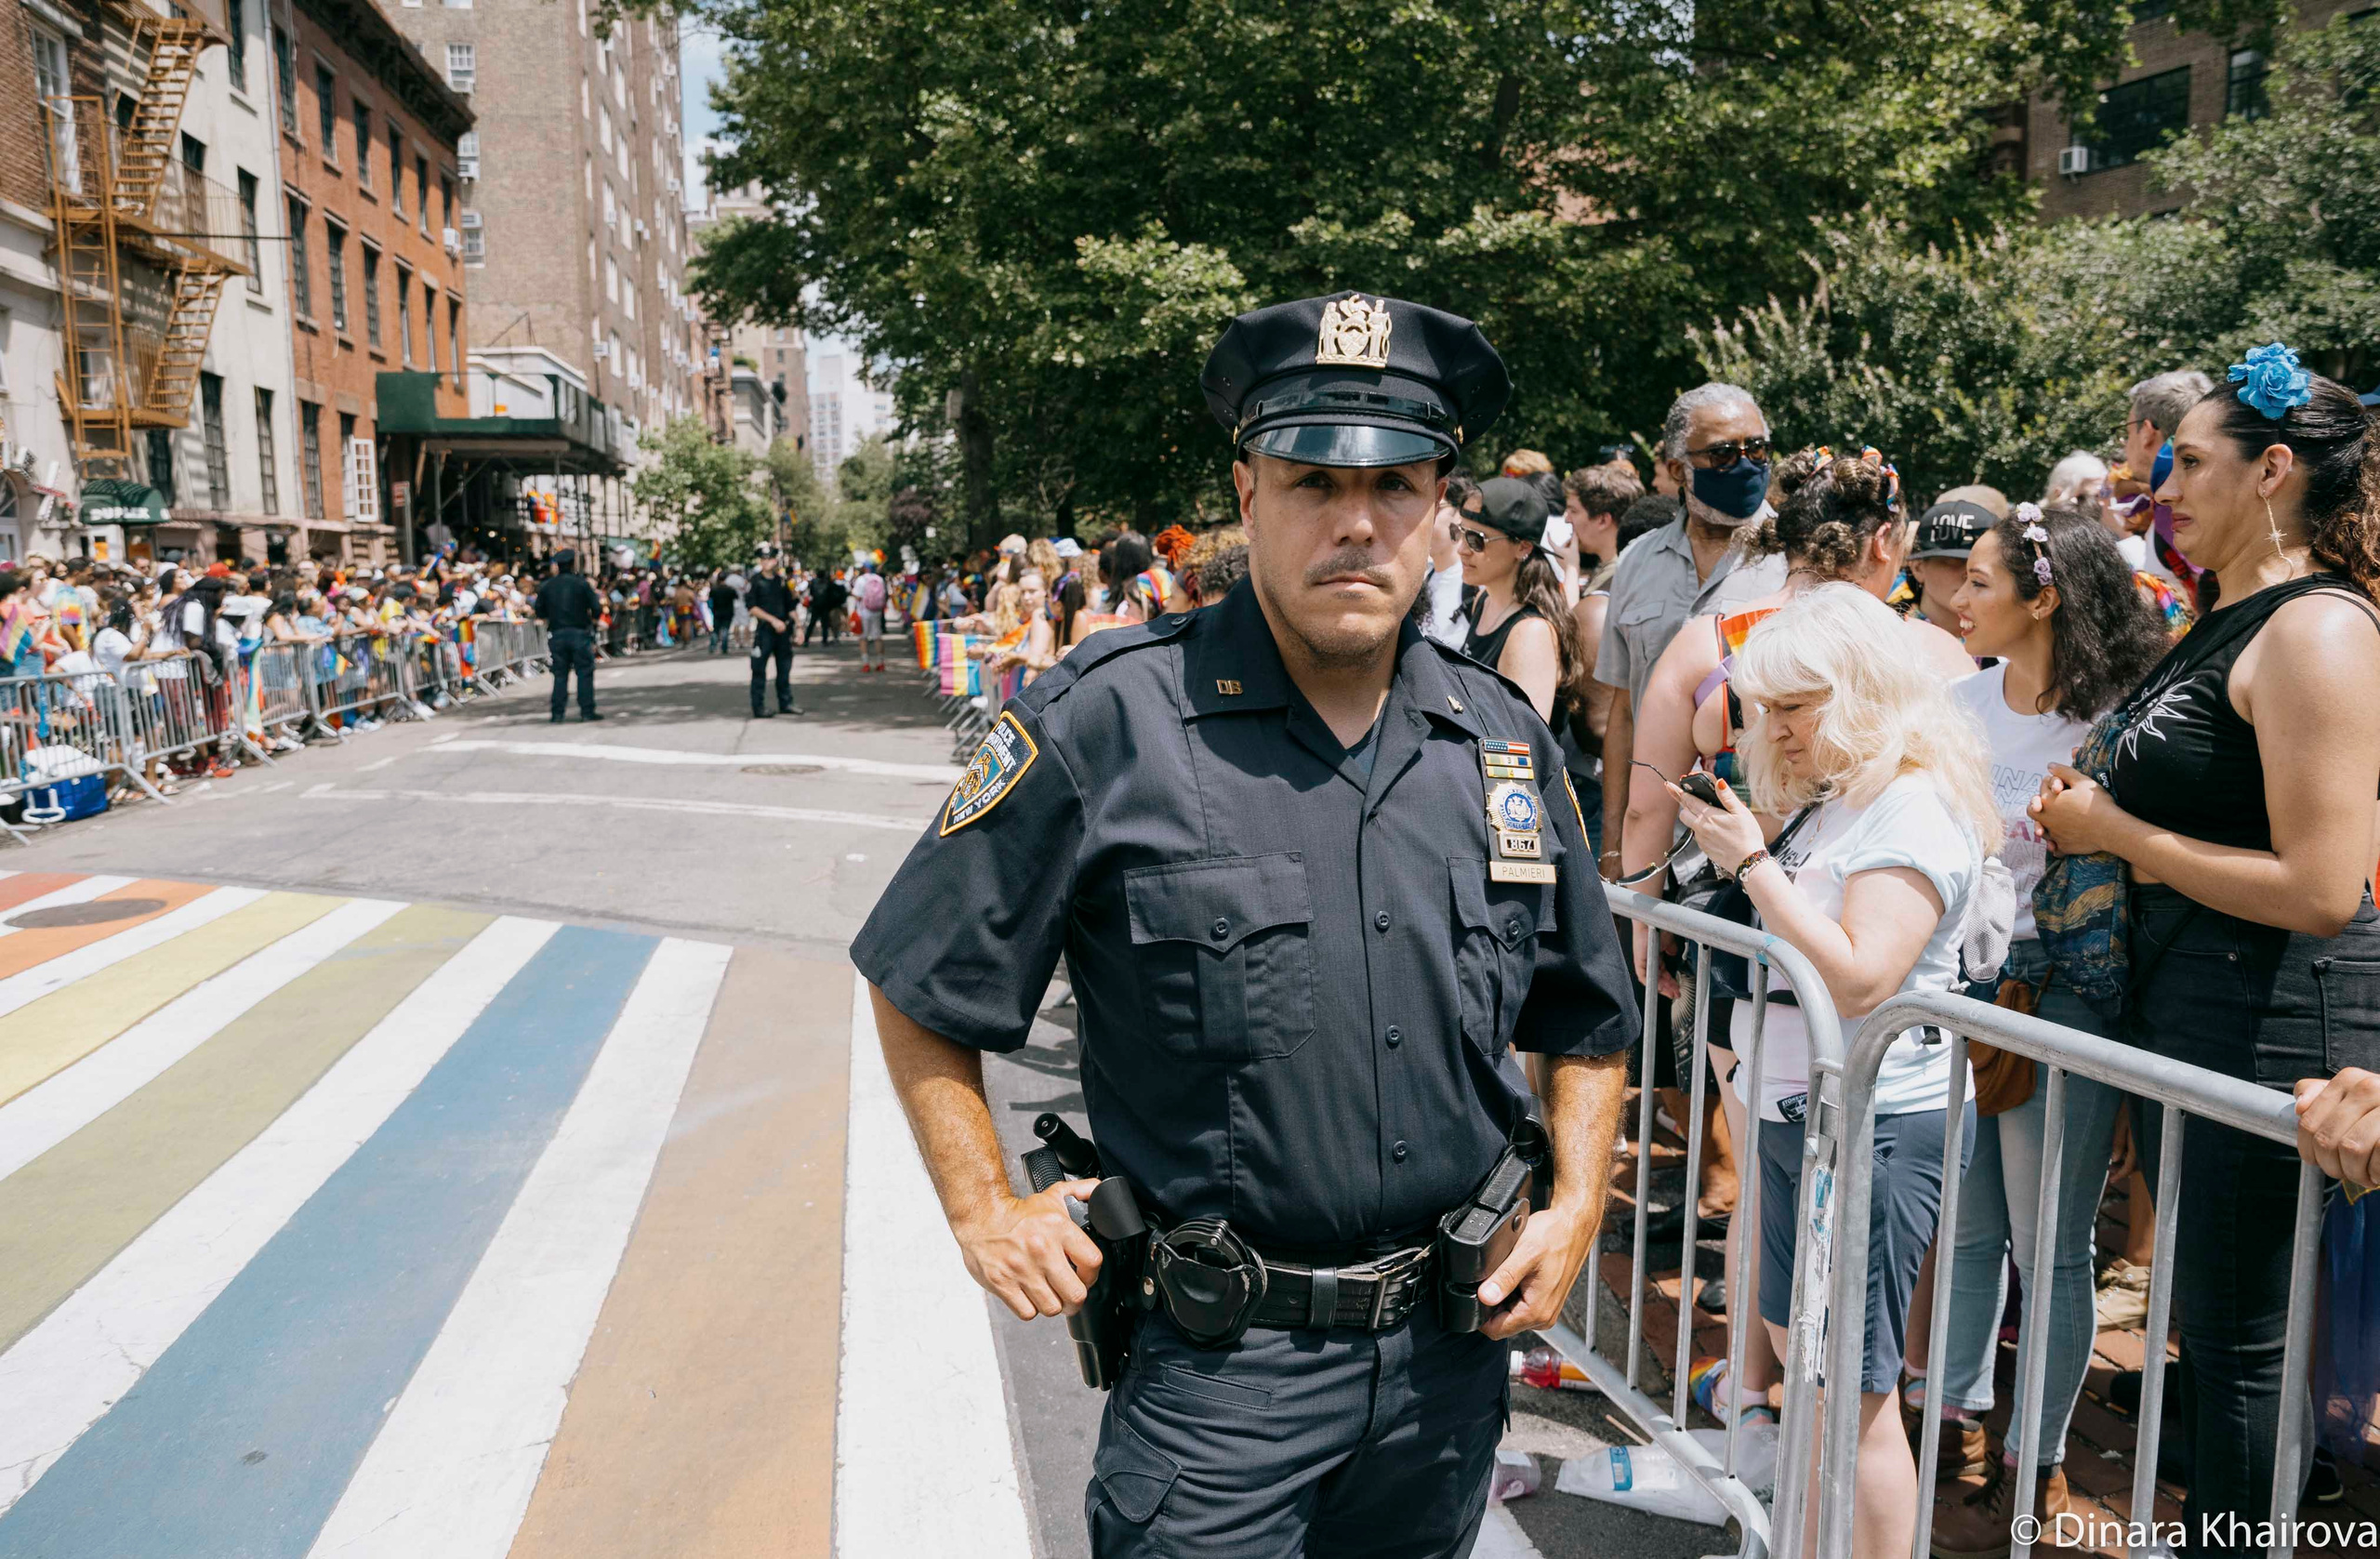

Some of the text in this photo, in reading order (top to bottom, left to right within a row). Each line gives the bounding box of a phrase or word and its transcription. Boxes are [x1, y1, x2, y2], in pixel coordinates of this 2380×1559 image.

[1930, 513, 1976, 543] LOVE
[994, 720, 1016, 747] POLICE
[953, 804, 973, 824] NEW
[973, 778, 1006, 808] YORK
[1510, 839, 1533, 851] 867
[1501, 865, 1546, 879] PALMIERI
